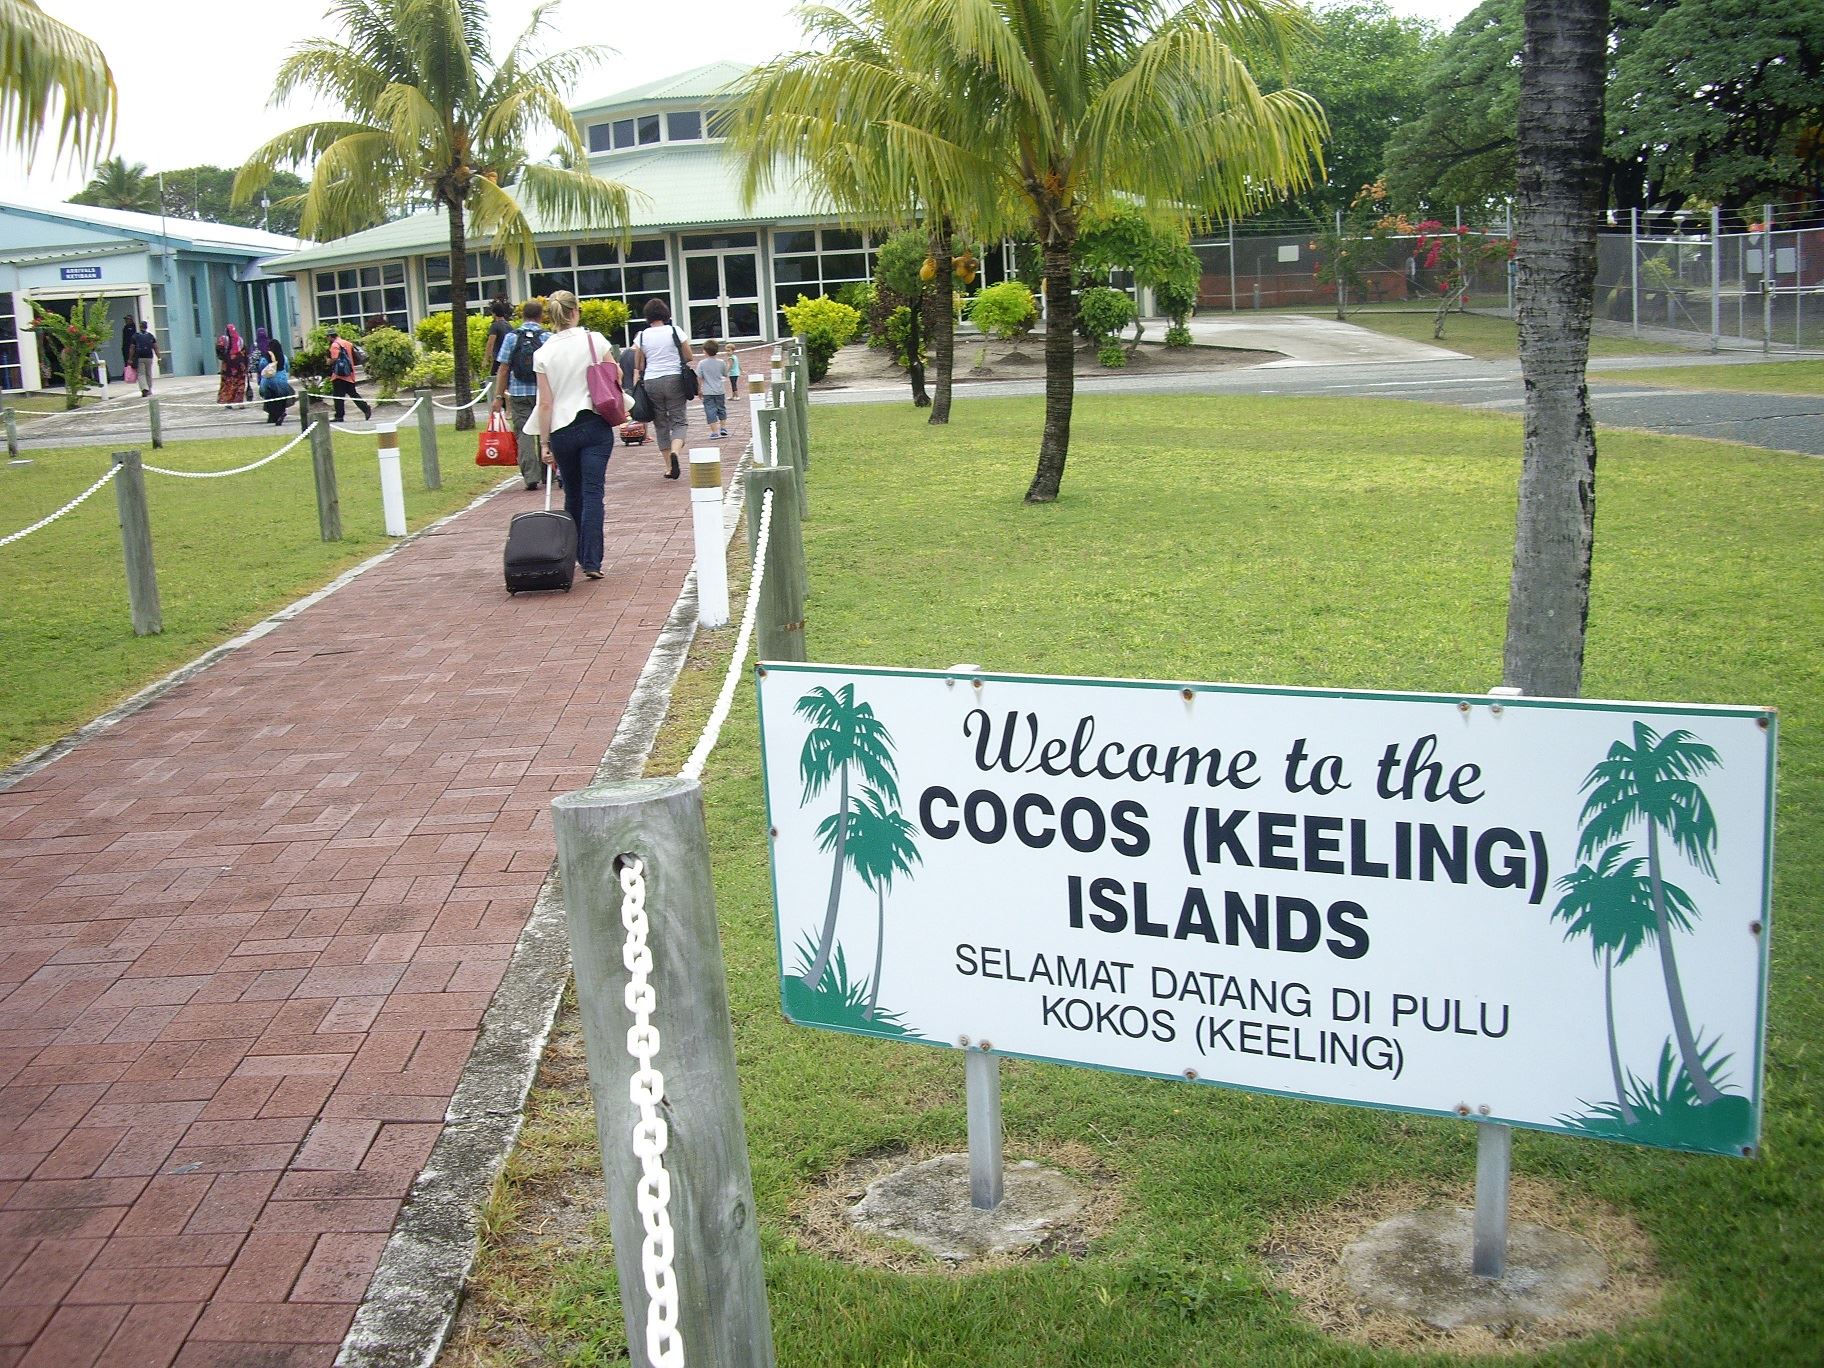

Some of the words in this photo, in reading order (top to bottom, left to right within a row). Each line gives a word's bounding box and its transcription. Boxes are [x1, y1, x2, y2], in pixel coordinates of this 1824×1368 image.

[963, 708, 1261, 790] Welcome
[1285, 737, 1352, 796] to
[1376, 733, 1485, 805] the
[919, 785, 1151, 858] COCOS
[1183, 806, 1549, 905] (KEELING)
[1067, 875, 1370, 960] ISLANDS
[956, 943, 1134, 994] SELAMAT
[1151, 966, 1312, 1018] DATANG
[1332, 987, 1370, 1024] DI
[1392, 993, 1509, 1039] PULU
[1042, 995, 1176, 1043] KOKOS
[1195, 1015, 1404, 1081] (KEELING)
